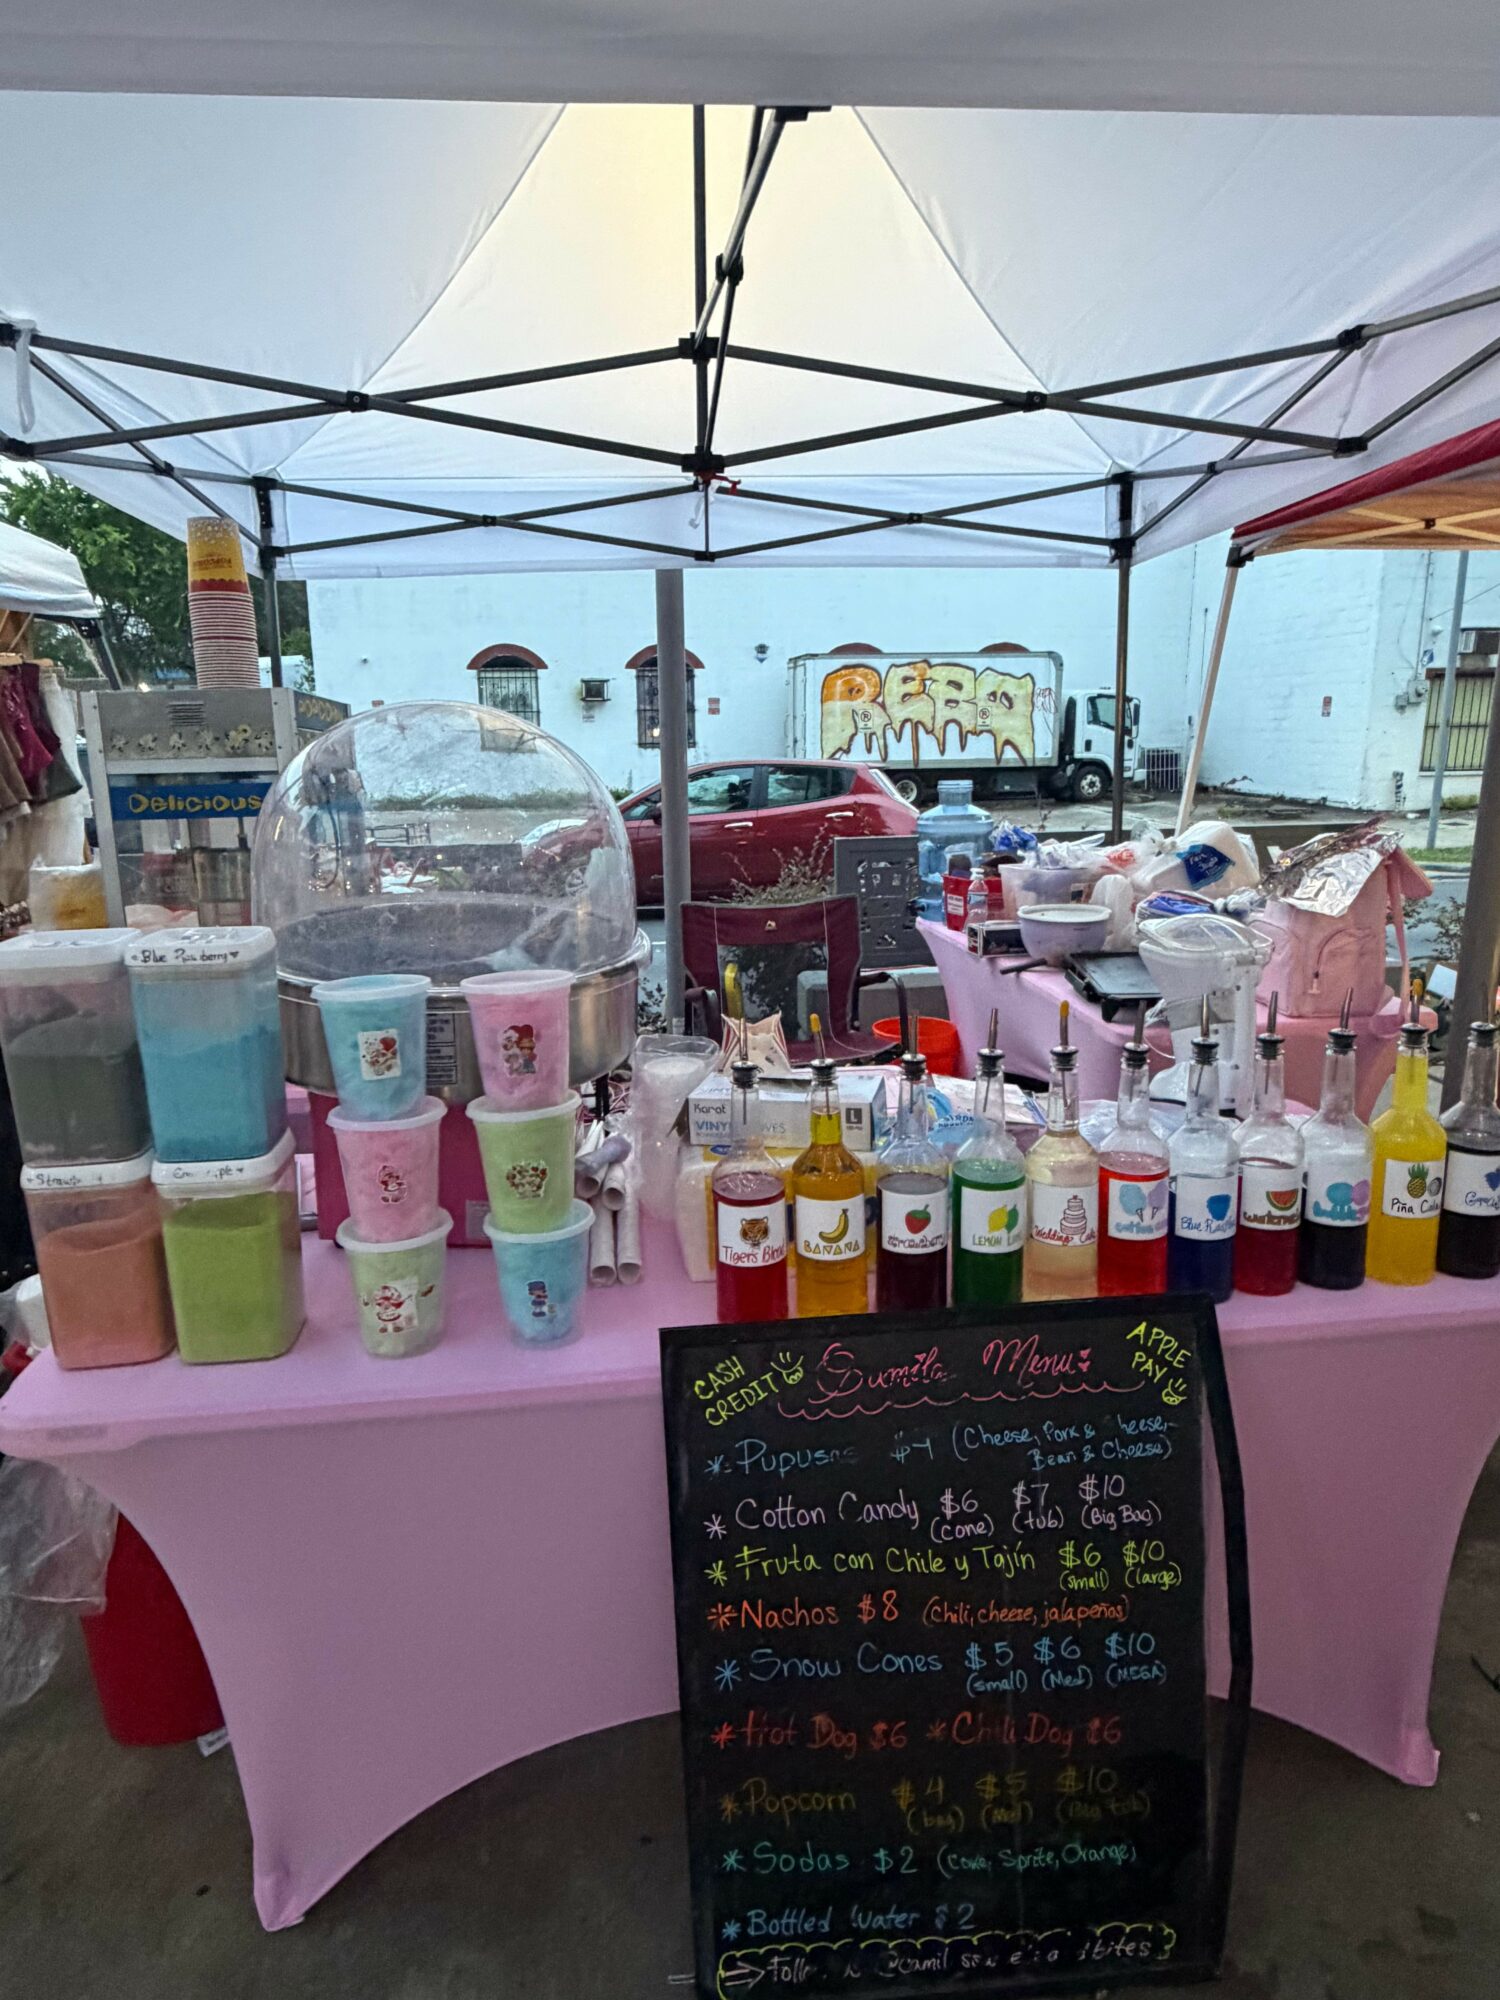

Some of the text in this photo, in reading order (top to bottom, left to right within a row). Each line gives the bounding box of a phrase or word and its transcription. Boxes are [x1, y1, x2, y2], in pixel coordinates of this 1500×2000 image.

[128, 793, 263, 813] Delicious
[693, 1103, 727, 1115] Karat
[695, 1121, 731, 1131] VINY
[1391, 1197, 1414, 1214] Piña
[803, 1240, 860, 1256] BANANA
[983, 1334, 1074, 1388] Menu
[1126, 1321, 1191, 1369] APPLE
[694, 1355, 745, 1400] CASH
[1132, 1351, 1168, 1384] PAY
[705, 1372, 780, 1426] CREDIT
[1042, 1420, 1080, 1441] Pork
[1084, 1423, 1097, 1439] &
[1026, 1448, 1077, 1472] Bean
[1082, 1445, 1095, 1463] &
[735, 1473, 1126, 1530] Cotton Candy $6 $7 $10
[1012, 1505, 1064, 1534] (tub)
[1081, 1506, 1117, 1531] (Big
[735, 1539, 1166, 1581] Fruta con Chile y Tajín $6 $10
[1059, 1561, 1182, 1592] (small) (large)
[740, 1596, 840, 1629] Nachos
[856, 1589, 900, 1625] $8
[749, 1632, 1156, 1682] Snow Cones $5 $6 $10
[966, 1668, 1028, 1698] (small)
[807, 1713, 857, 1761] Dog
[870, 1720, 908, 1750] $6
[1024, 1712, 1074, 1758] Dog
[742, 1777, 857, 1828] Popcorn
[753, 1840, 850, 1874] Sodas
[873, 1845, 919, 1874] $2
[747, 1905, 833, 1936] Bottled
